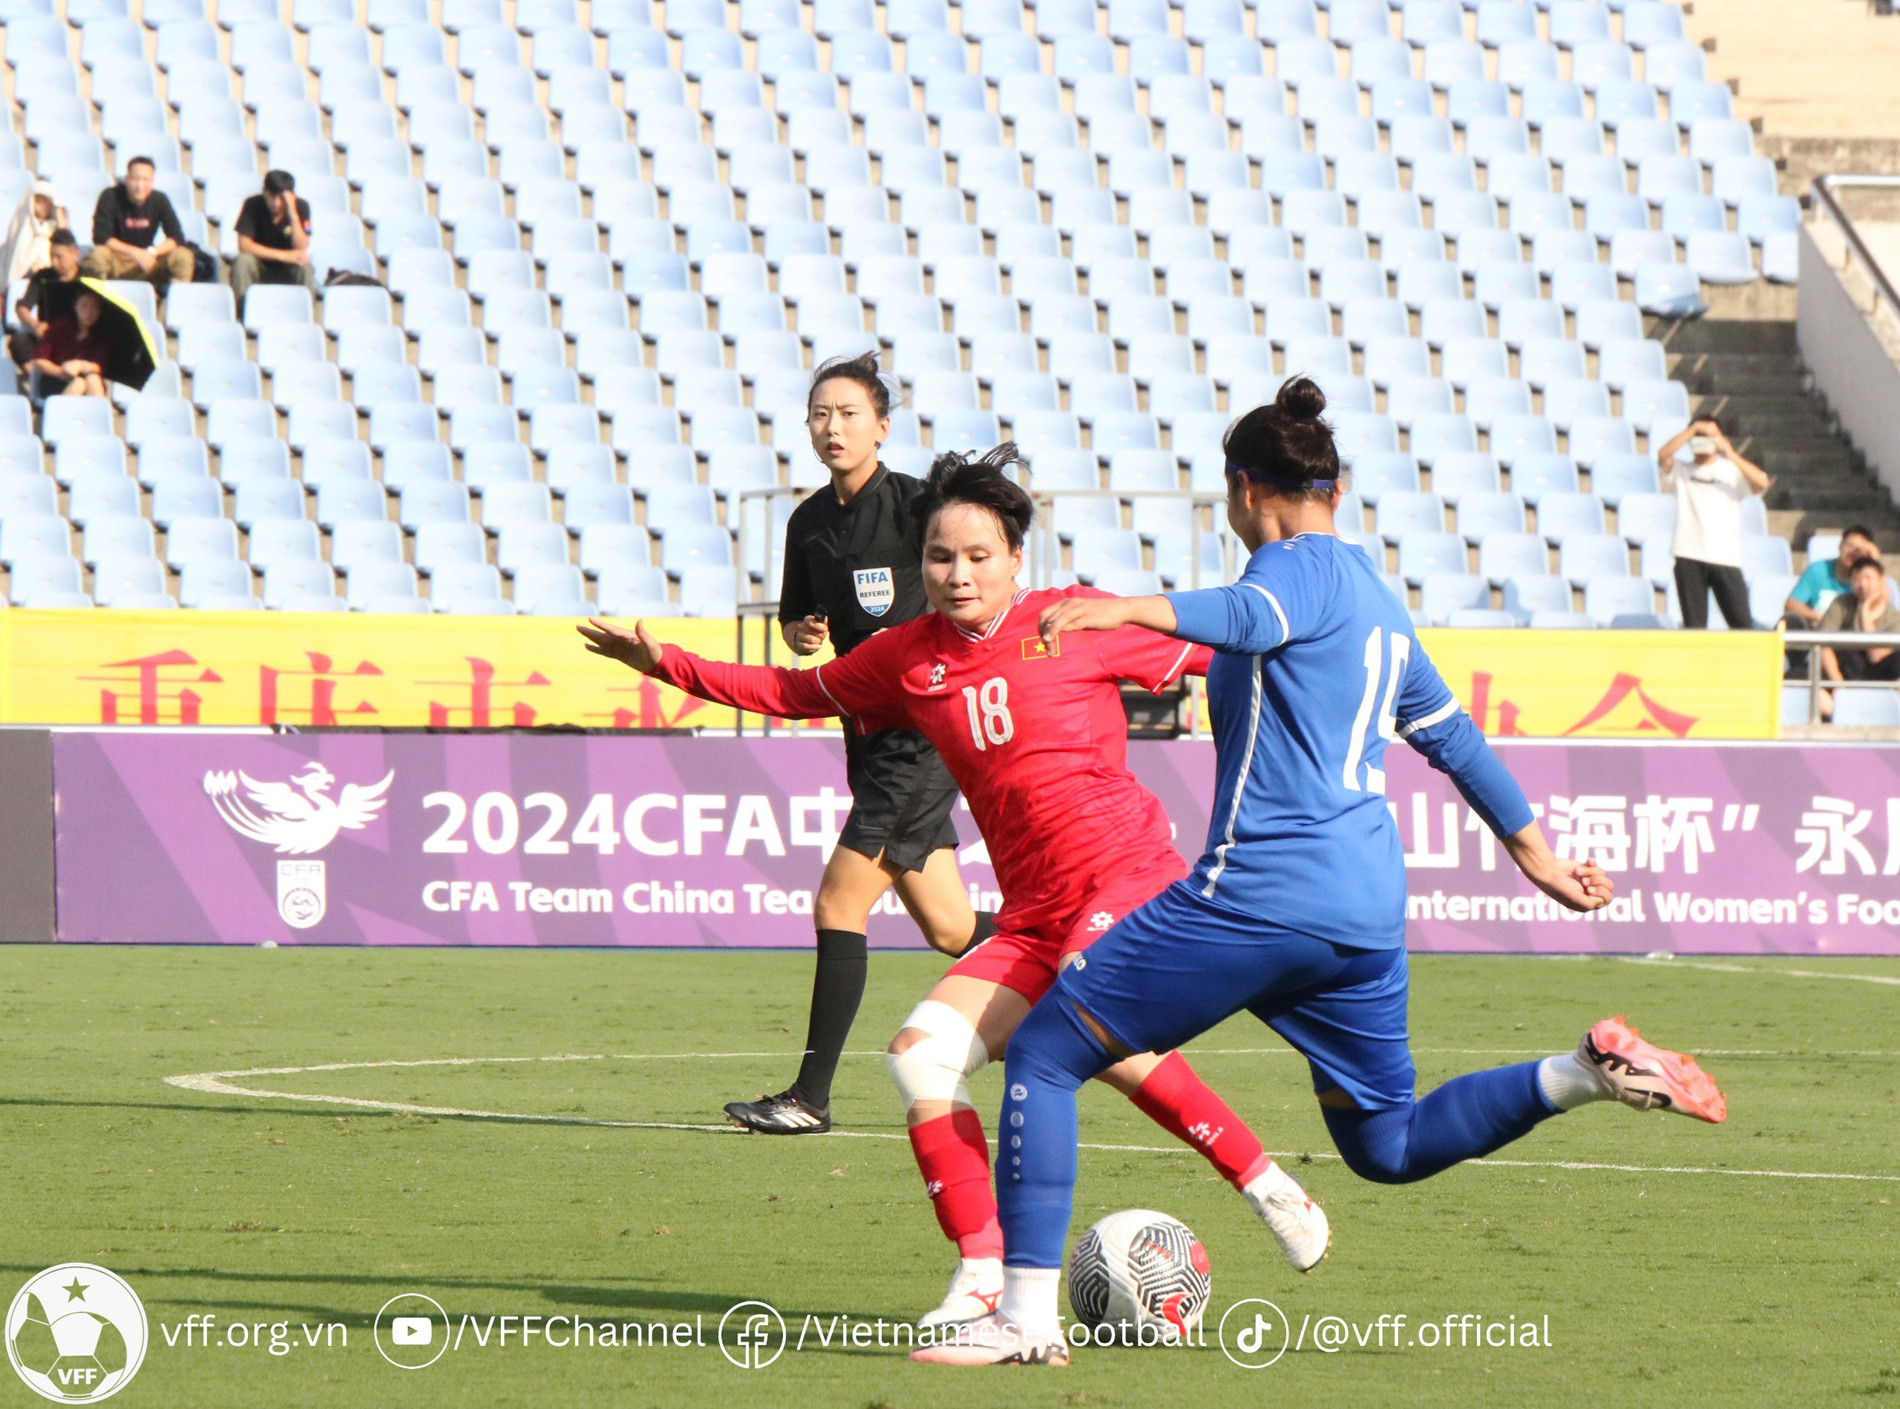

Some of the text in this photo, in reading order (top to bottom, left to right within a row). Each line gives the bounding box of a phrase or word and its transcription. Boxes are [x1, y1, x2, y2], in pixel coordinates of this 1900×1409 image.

[857, 571, 888, 585] FIFA
[860, 589, 891, 598] REFEREE
[961, 676, 1015, 752] 18
[422, 881, 499, 912] CFA
[508, 881, 613, 913] Team
[623, 880, 734, 914] China
